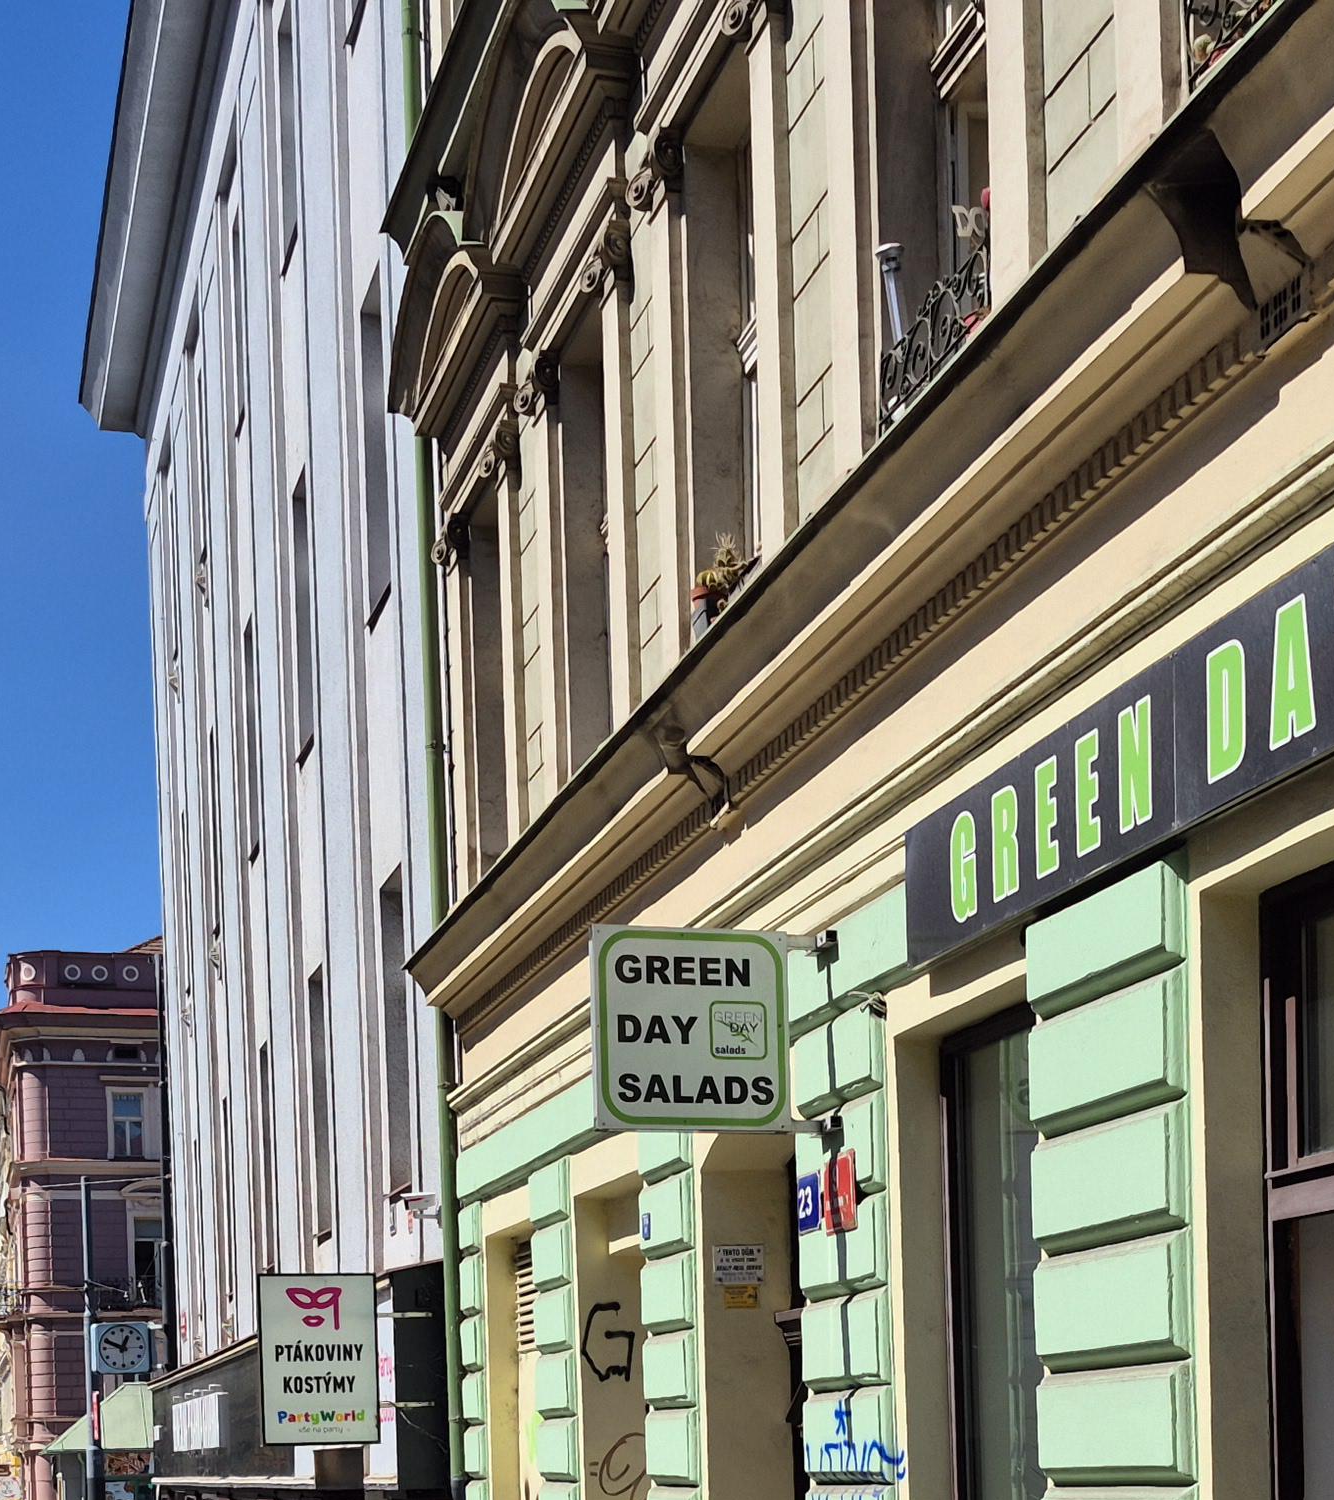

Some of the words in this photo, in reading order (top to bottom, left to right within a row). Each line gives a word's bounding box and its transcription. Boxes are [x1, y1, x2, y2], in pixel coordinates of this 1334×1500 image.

[948, 693, 1153, 925] GREEN
[613, 954, 752, 987] GREEN
[714, 1011, 763, 1023] GREEN
[730, 1022, 759, 1033] DAY
[616, 1014, 698, 1045] DAY
[715, 1045, 747, 1054] salads
[617, 1073, 775, 1106] SALADS
[798, 1185, 813, 1219] 23
[274, 1340, 363, 1362] PTÁKOVINY
[283, 1371, 356, 1394] KOSTÝMY
[277, 1409, 365, 1425] PartyWorld
